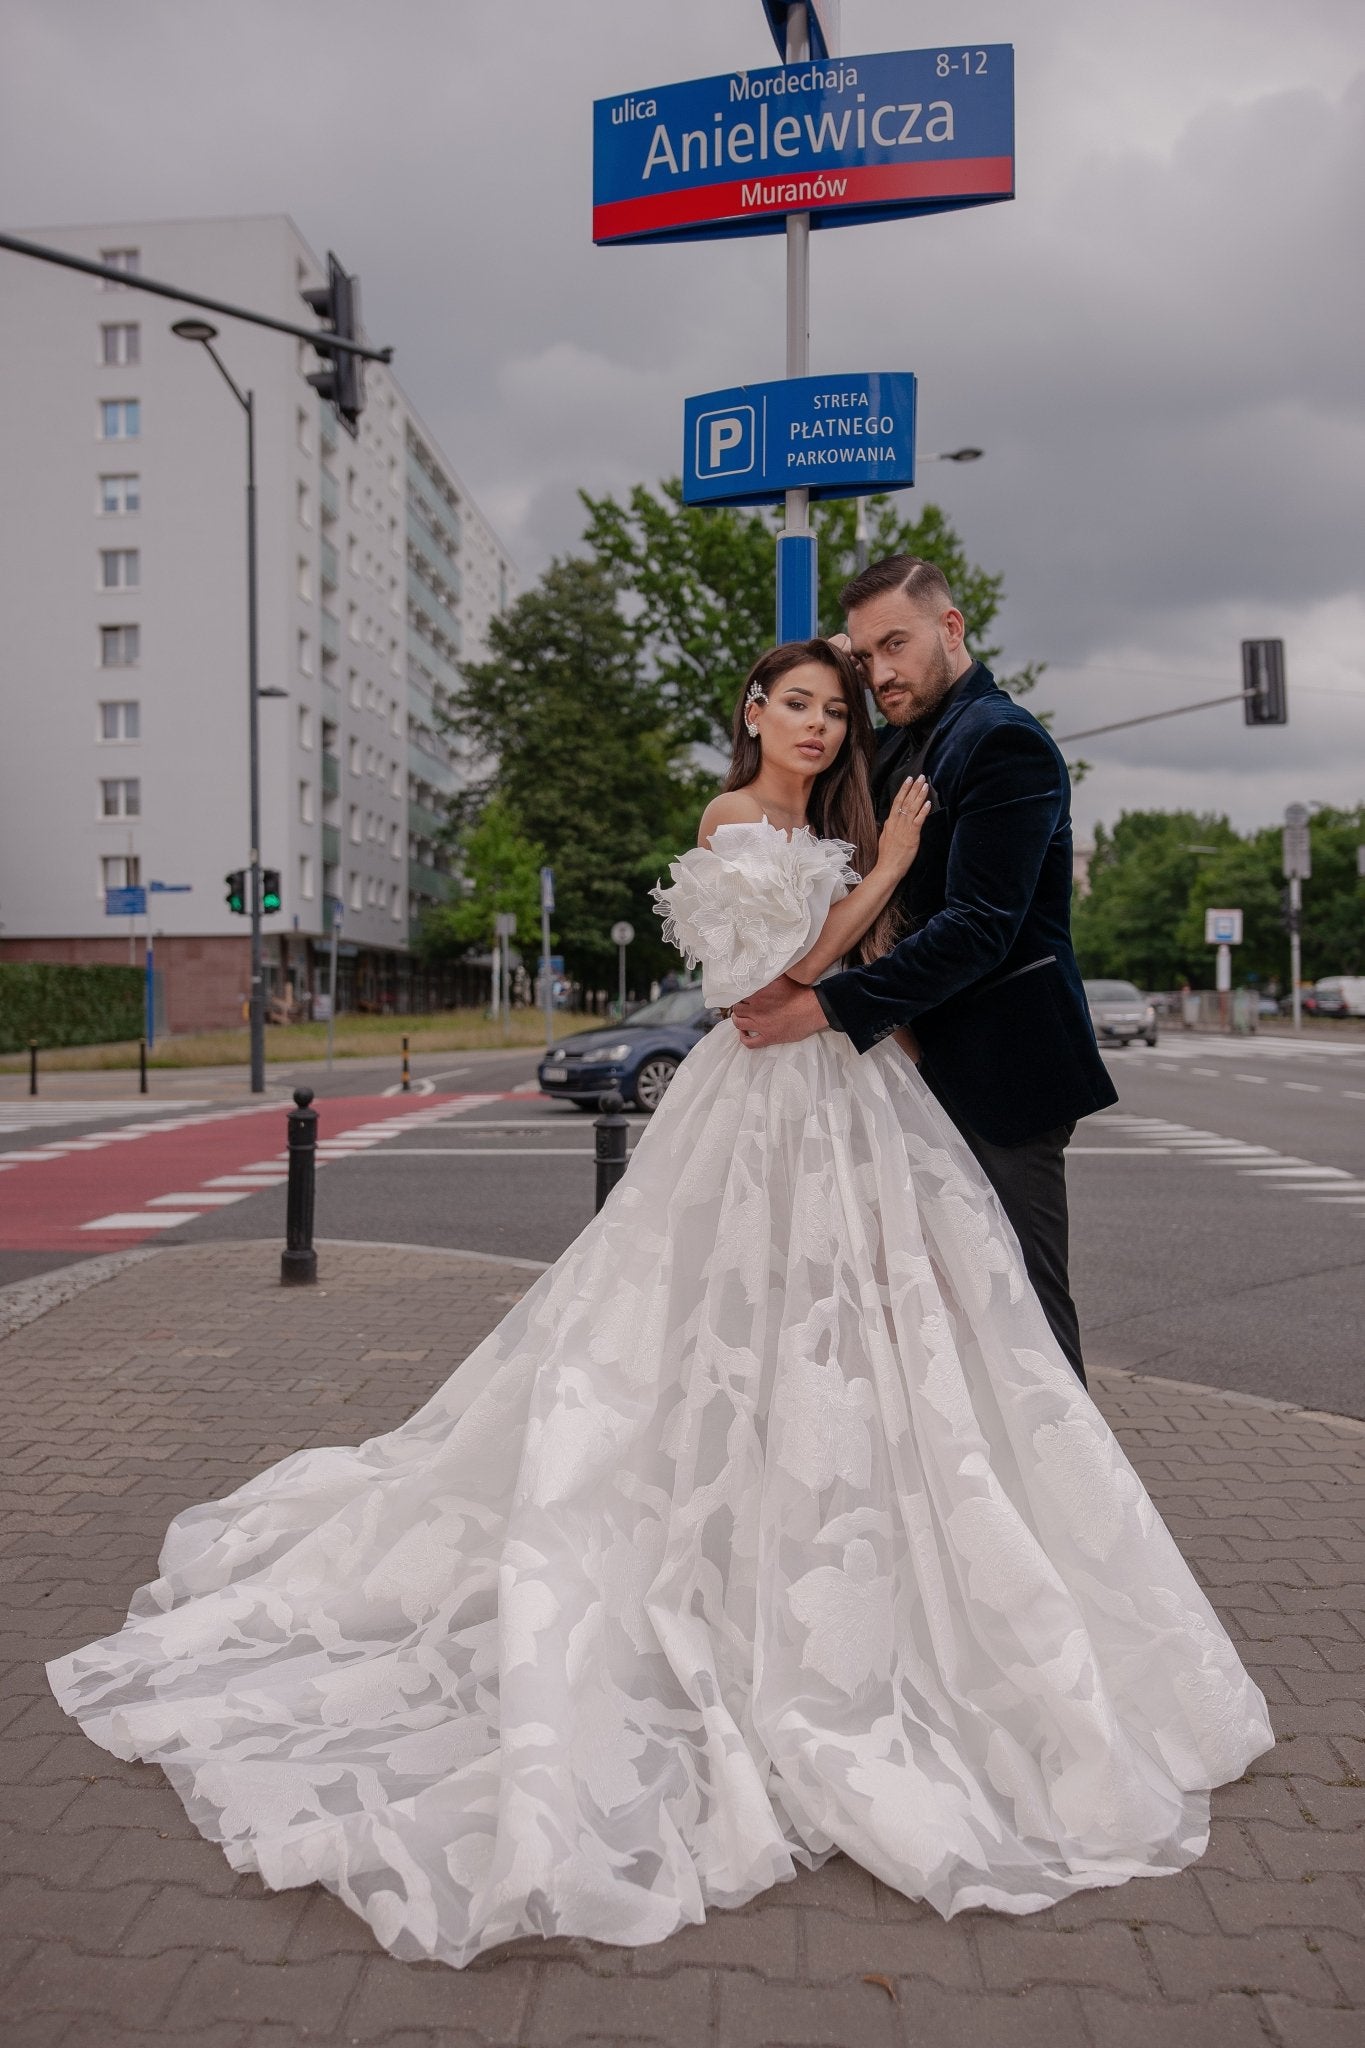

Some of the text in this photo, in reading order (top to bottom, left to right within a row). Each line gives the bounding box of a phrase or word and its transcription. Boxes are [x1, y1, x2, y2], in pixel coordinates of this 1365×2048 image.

[936, 51, 988, 77] 8-12
[729, 63, 858, 103] Mordechaja
[611, 97, 657, 125] ulica
[641, 94, 955, 180] Anielewicza
[741, 174, 848, 207] Muranów
[813, 392, 869, 410] STREFA
[790, 416, 894, 440] PŁATNEGO
[709, 418, 743, 468] P
[787, 446, 896, 467] PARKOWANIA
